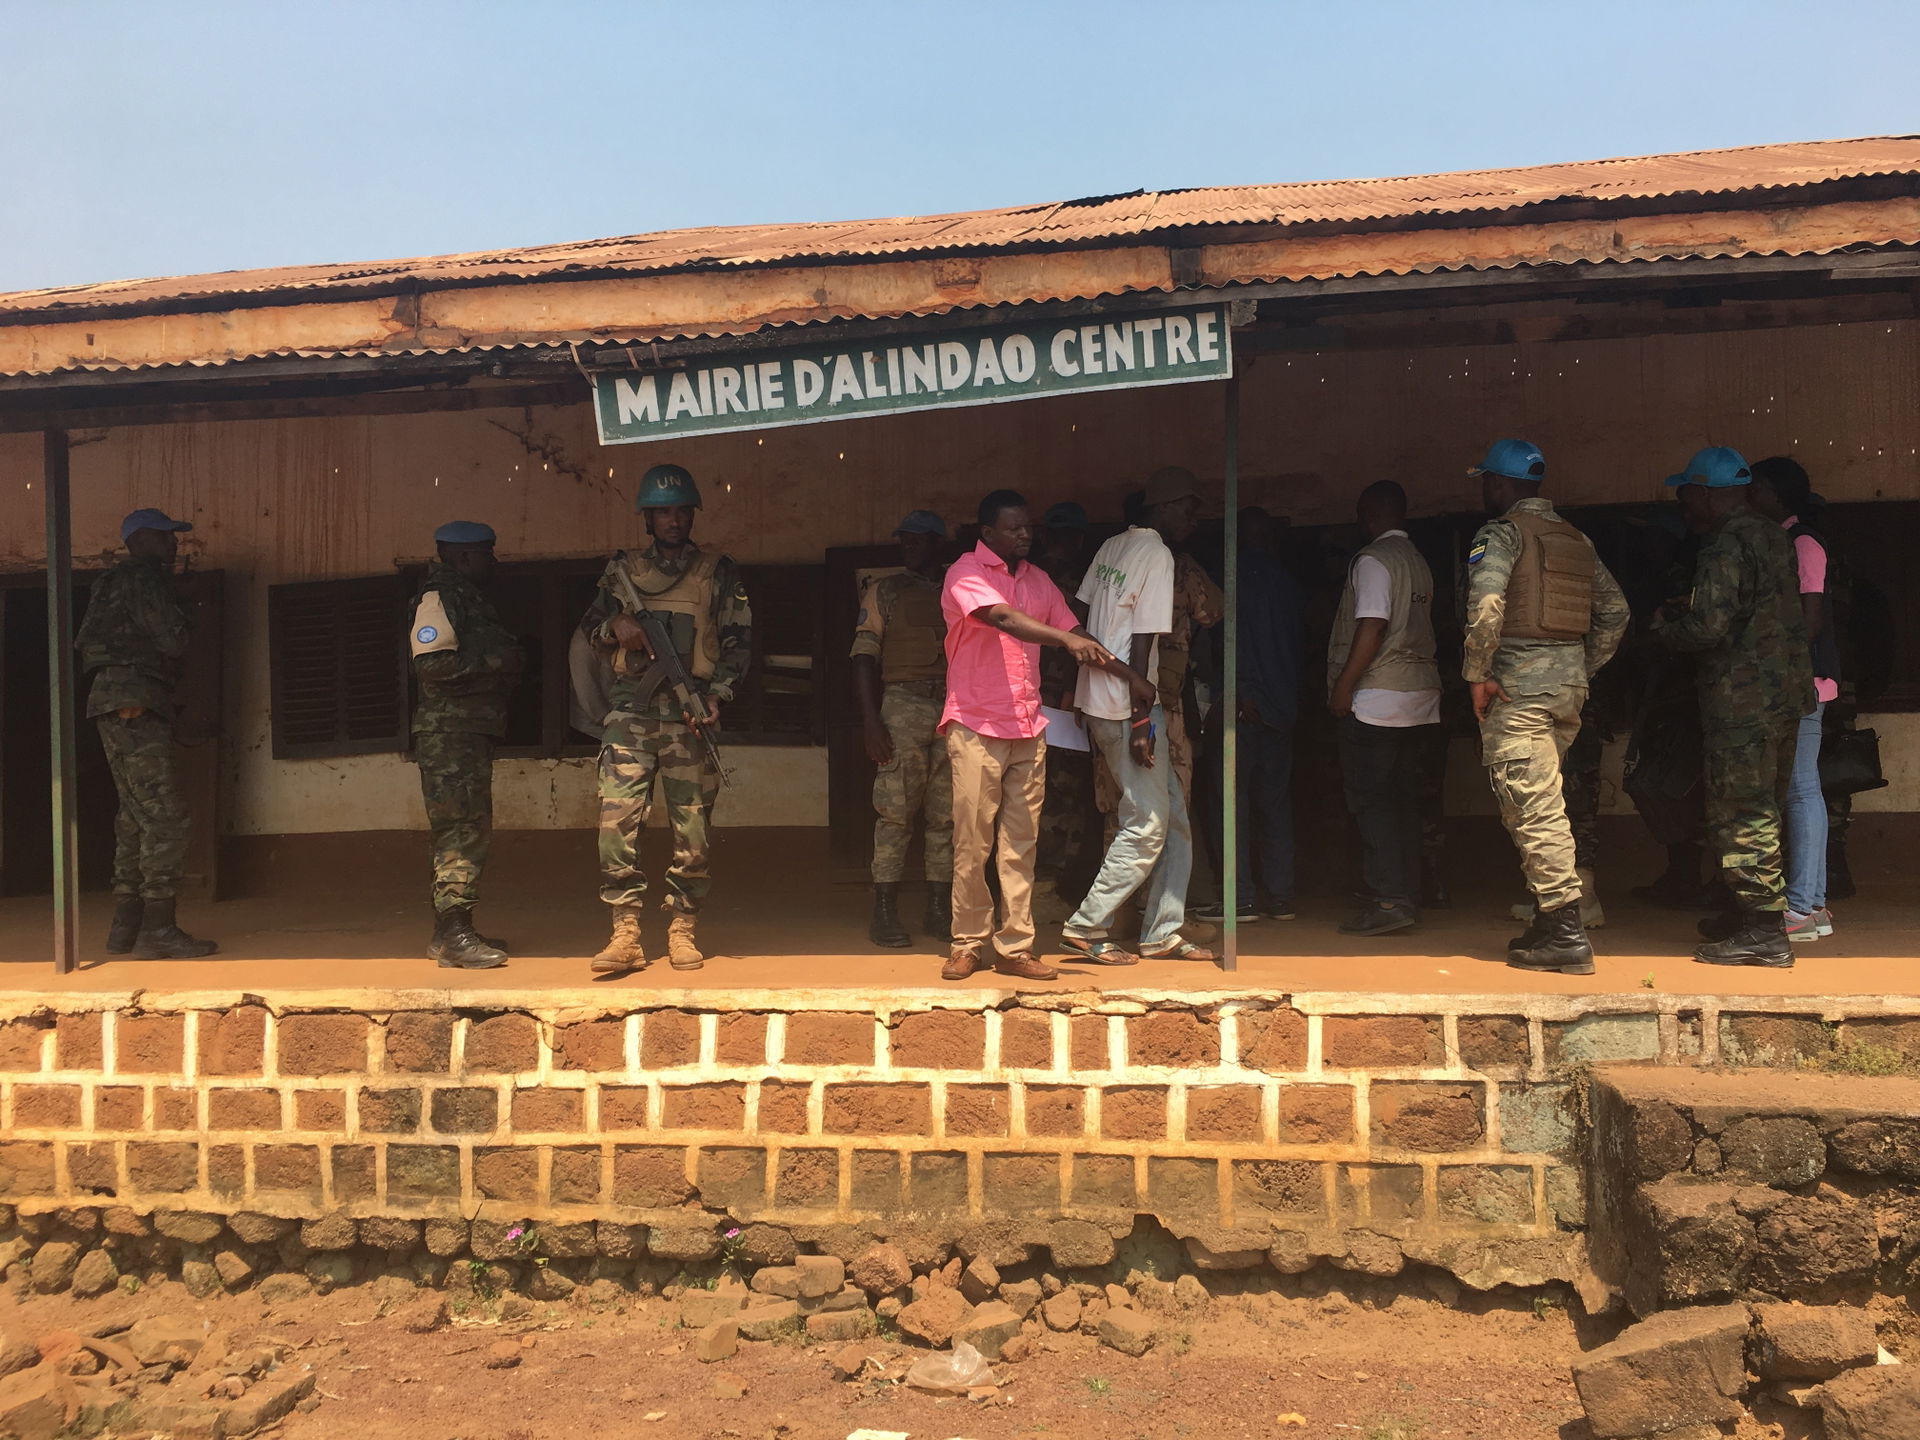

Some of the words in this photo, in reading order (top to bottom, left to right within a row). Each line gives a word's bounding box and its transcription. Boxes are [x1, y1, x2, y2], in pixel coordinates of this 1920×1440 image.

[615, 361, 785, 425] MAIRIE
[792, 333, 1037, 408] D'ALINDAO
[1050, 311, 1220, 377] CENTRE
[656, 475, 682, 489] UN
